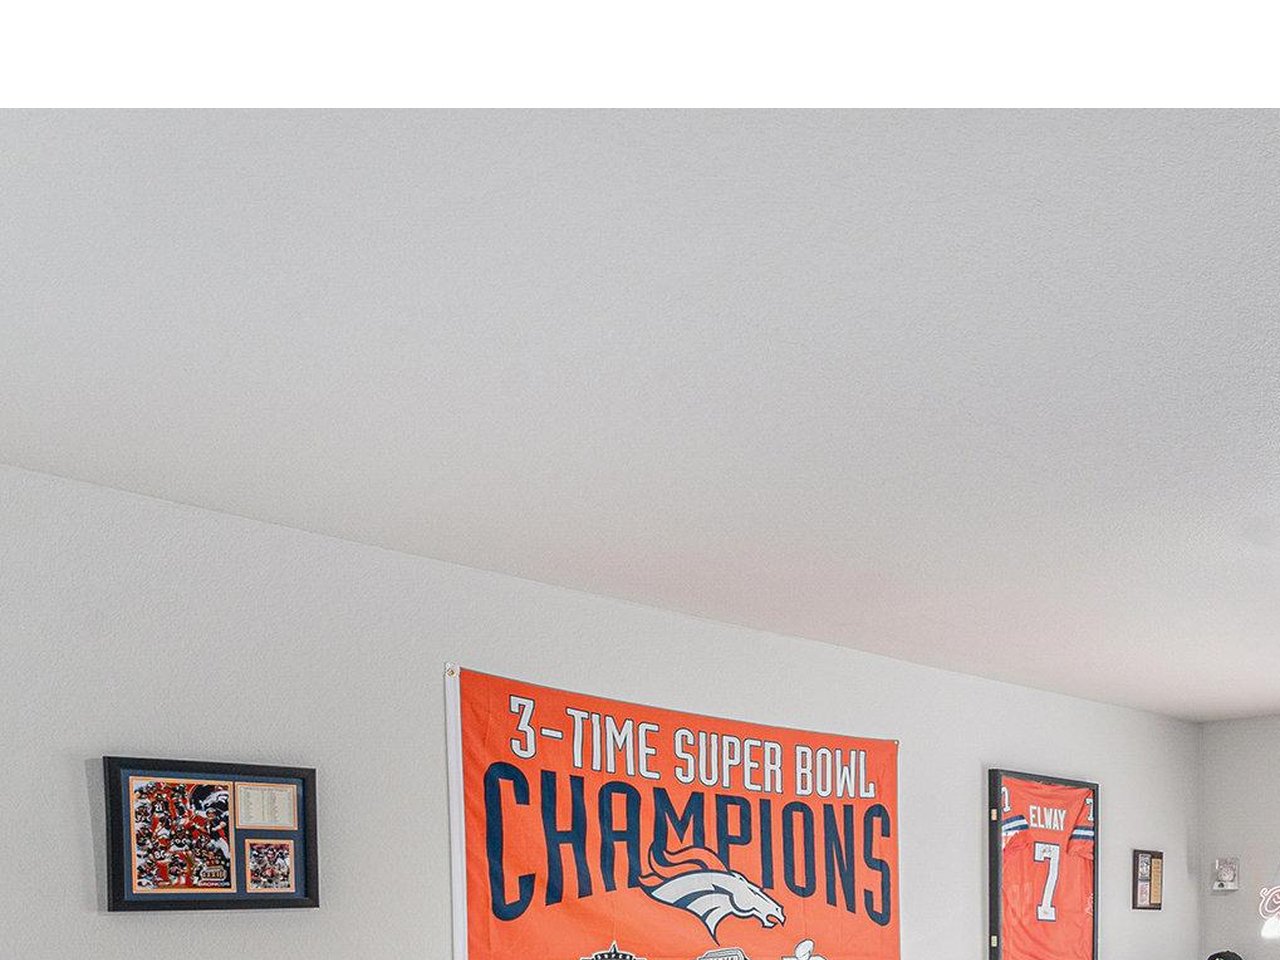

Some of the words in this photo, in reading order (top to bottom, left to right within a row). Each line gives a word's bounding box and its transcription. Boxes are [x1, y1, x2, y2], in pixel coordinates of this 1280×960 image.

[509, 695, 661, 780] 3-TIME
[674, 727, 783, 794] SUPER
[795, 744, 876, 799] BOWL
[484, 761, 891, 926] CHAMPIONS
[1029, 805, 1066, 831] ELWAY
[1034, 842, 1060, 922] 7
